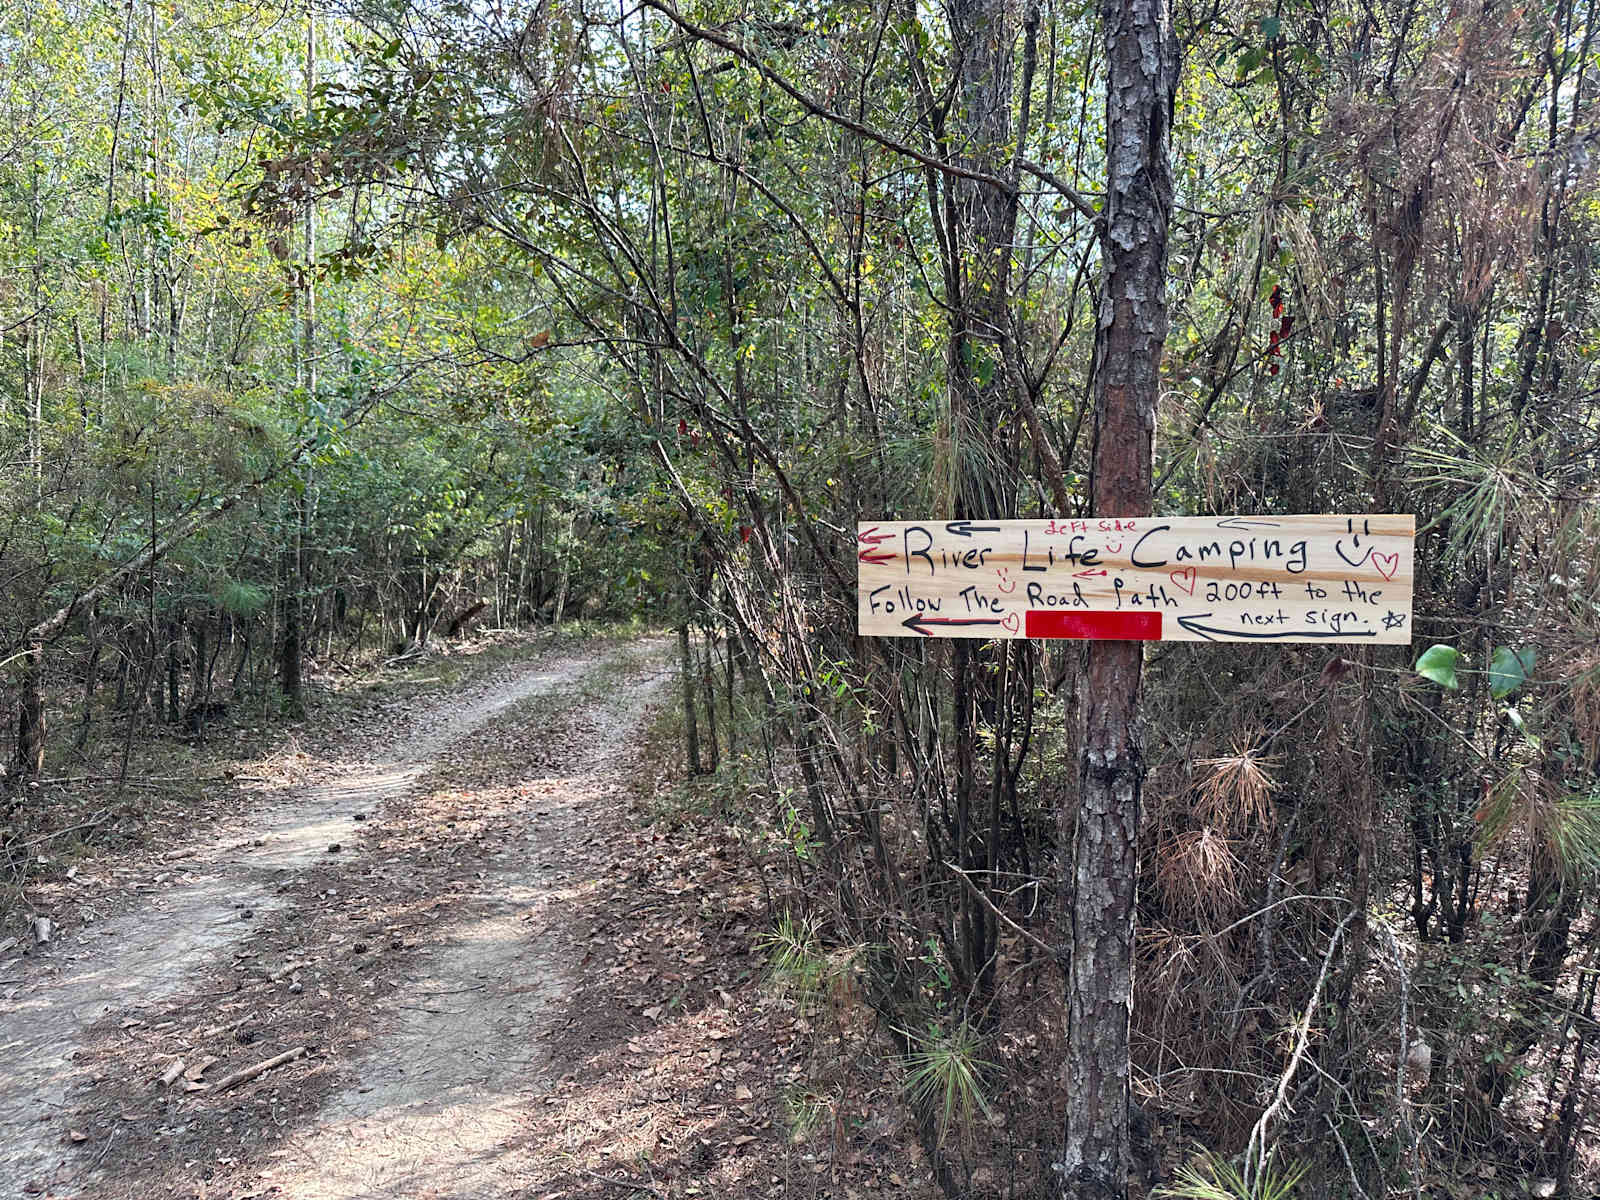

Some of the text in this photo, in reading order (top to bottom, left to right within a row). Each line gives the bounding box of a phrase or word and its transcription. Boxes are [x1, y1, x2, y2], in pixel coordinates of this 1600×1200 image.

[904, 525, 1308, 576] River Life Camping
[869, 577, 1383, 615] Follow The Road Path 200ft to the
[1240, 608, 1369, 633] next sign.
